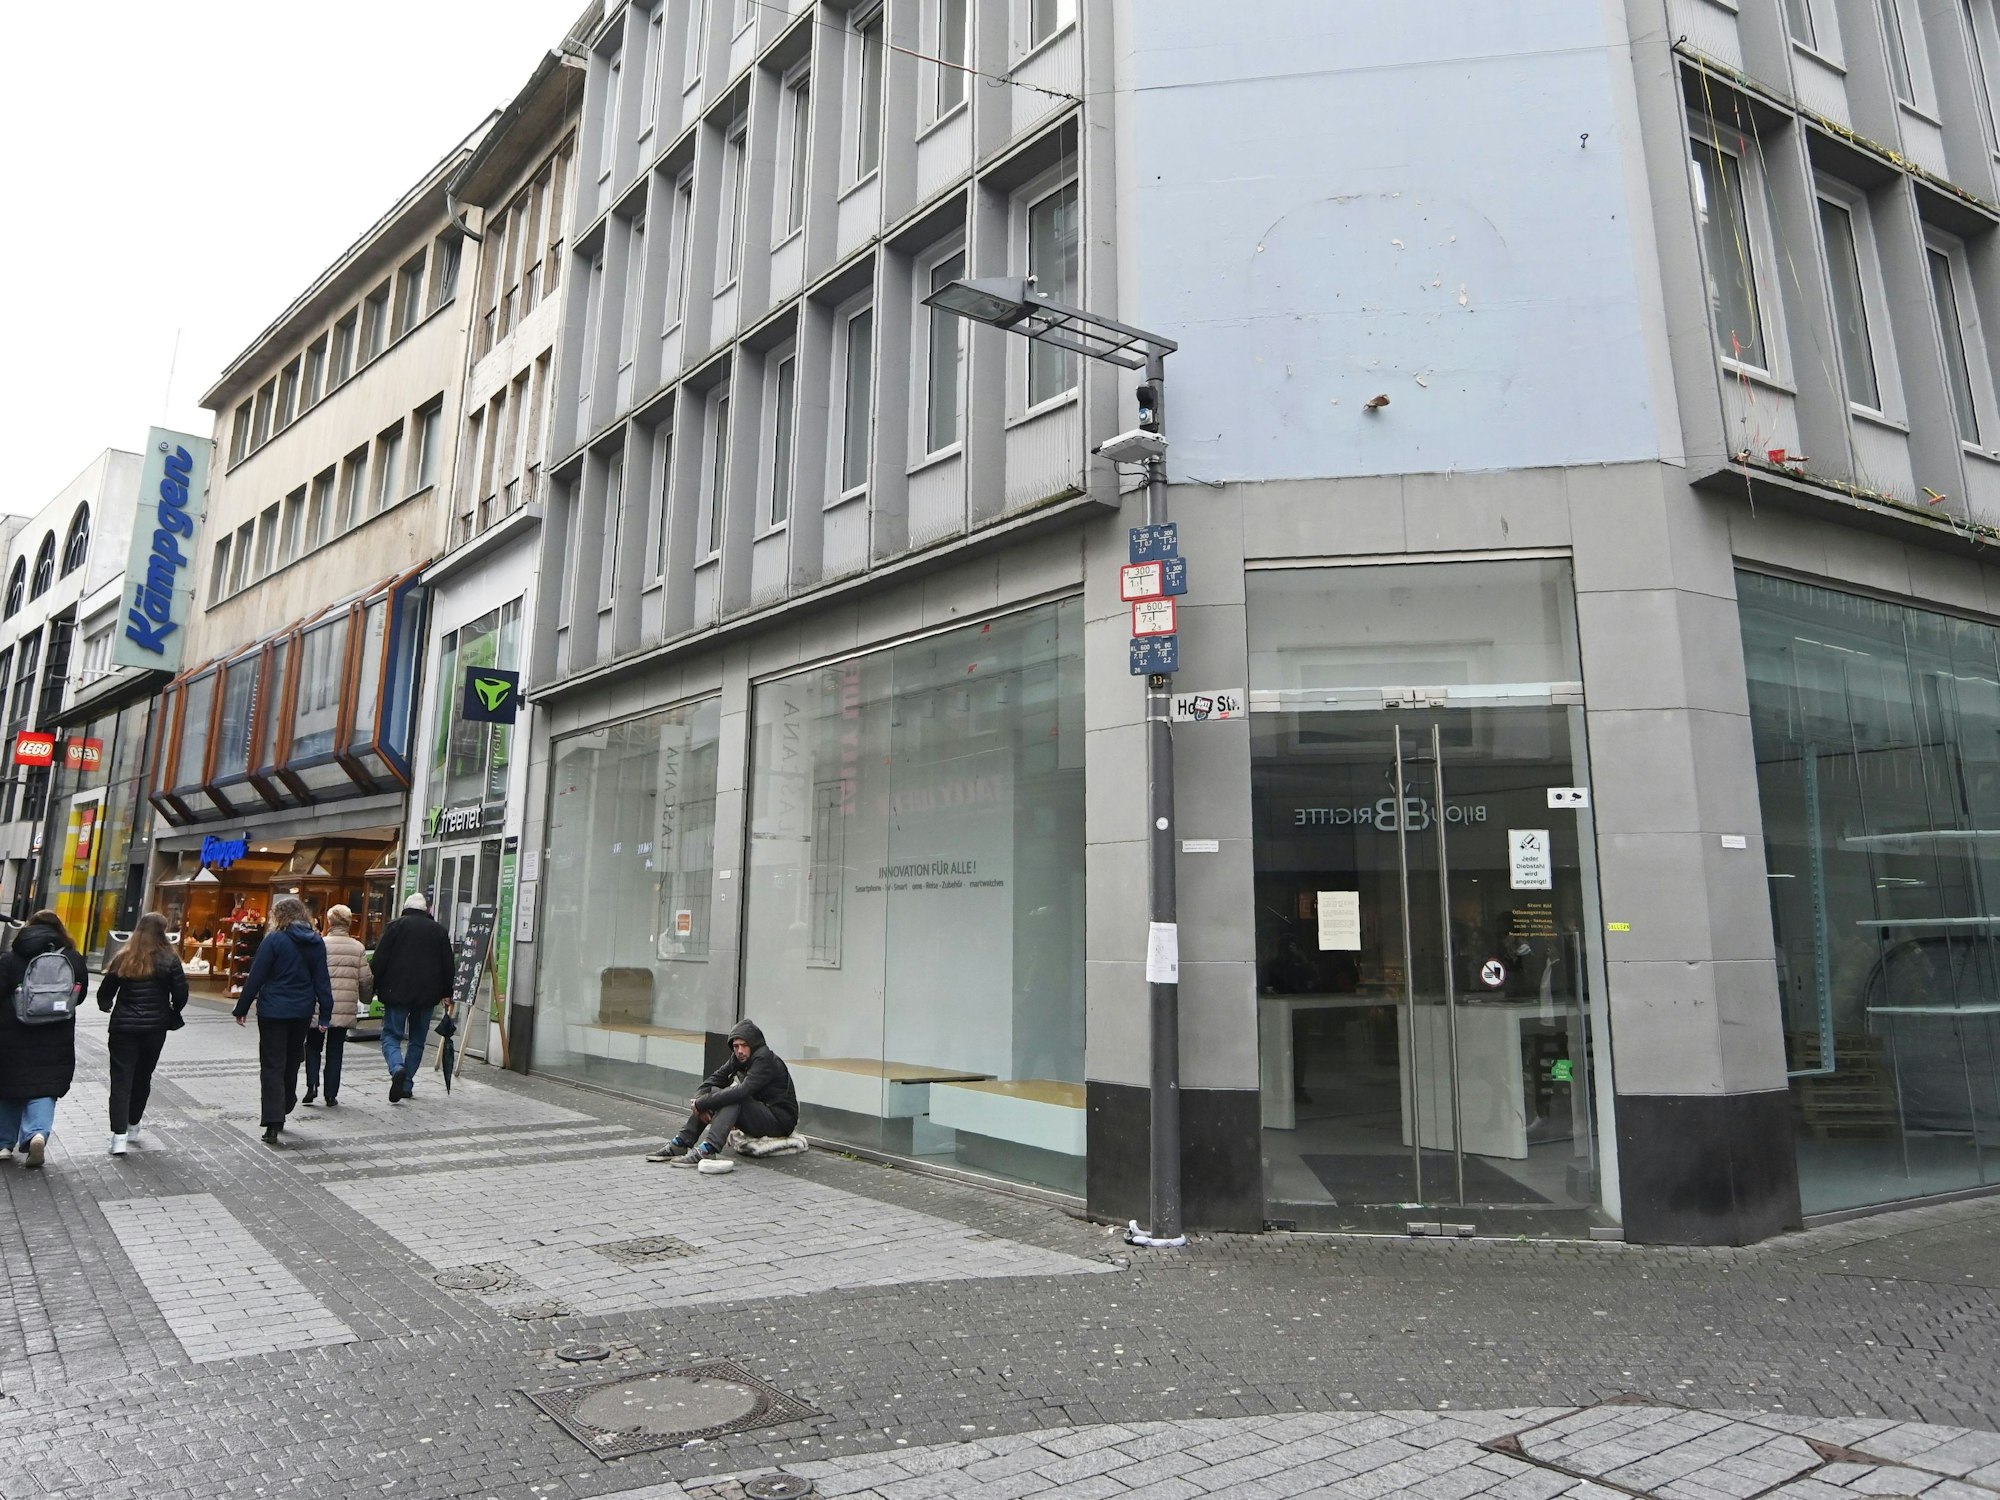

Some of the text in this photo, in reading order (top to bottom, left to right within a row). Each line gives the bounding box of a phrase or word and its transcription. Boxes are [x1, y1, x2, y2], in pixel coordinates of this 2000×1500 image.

[126, 445, 193, 655] Kämpgen
[1135, 567, 1150, 575] 300
[1147, 602, 1162, 610] 600
[1153, 676, 1163, 684] 13
[1178, 698, 1213, 715] Ho
[19, 742, 50, 755] LEGO
[441, 804, 482, 834] freenet
[879, 863, 930, 879] INNOVATION
[931, 860, 949, 875] FÜR
[942, 880, 963, 889] Zubehör
